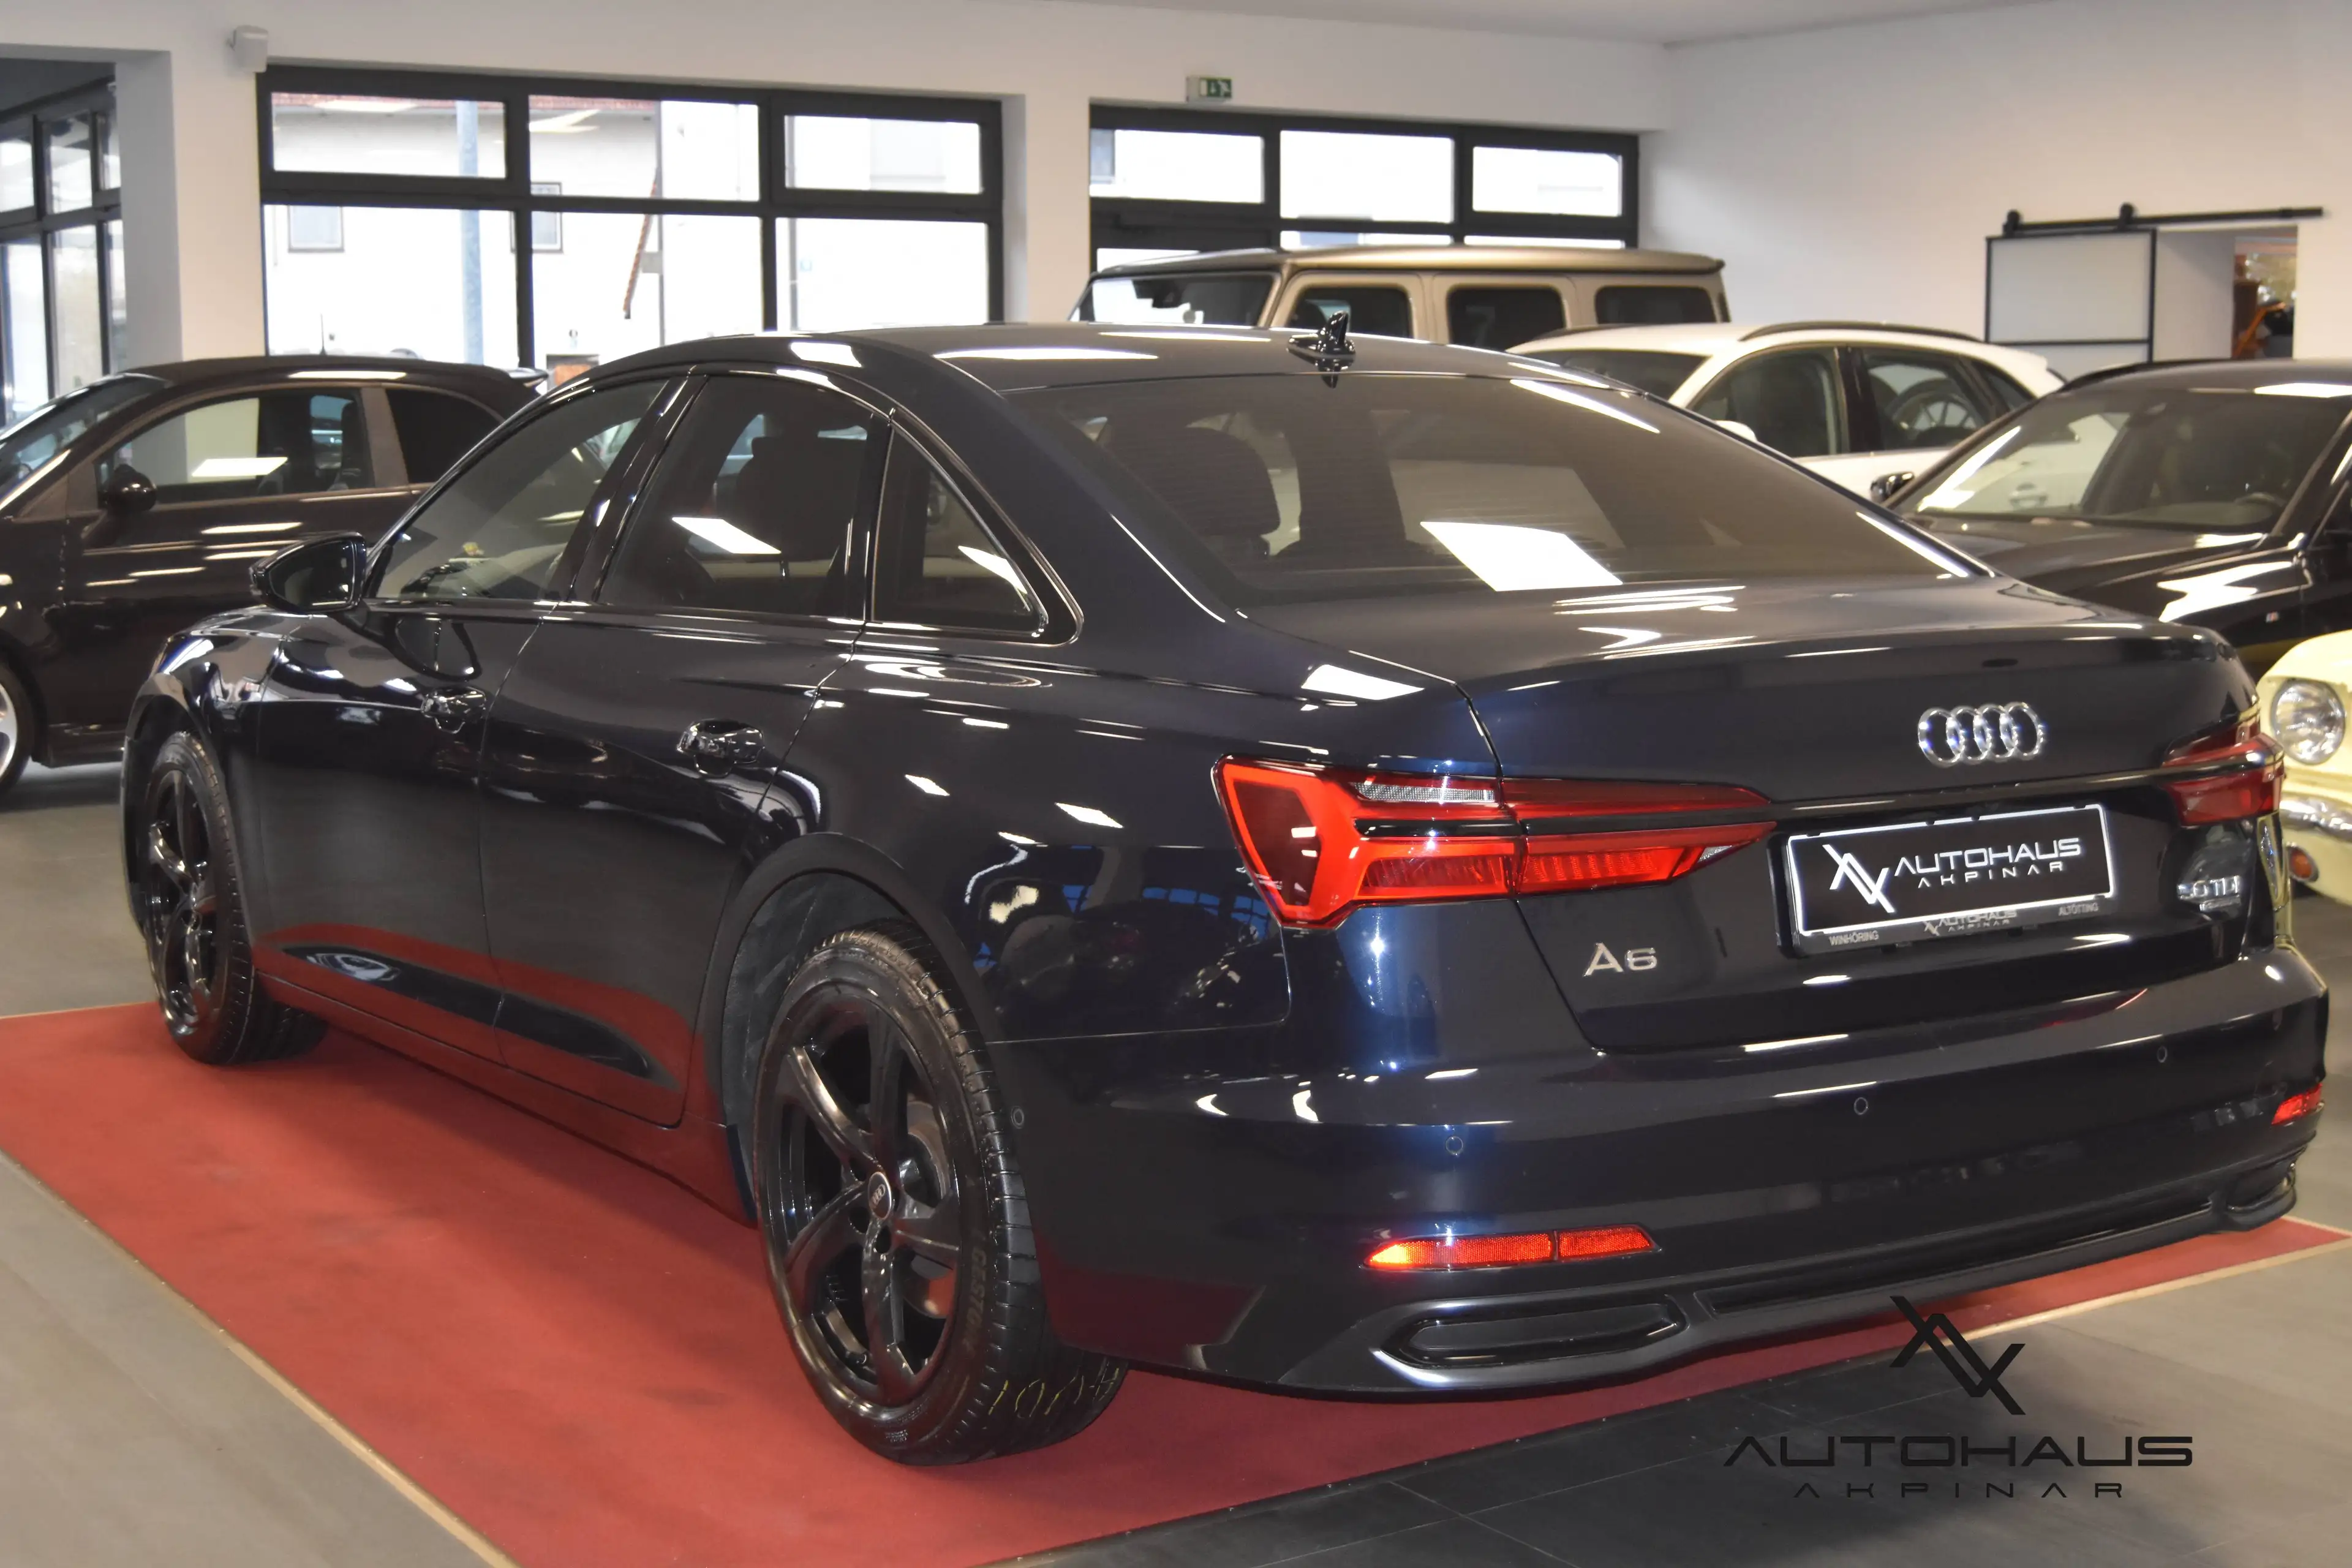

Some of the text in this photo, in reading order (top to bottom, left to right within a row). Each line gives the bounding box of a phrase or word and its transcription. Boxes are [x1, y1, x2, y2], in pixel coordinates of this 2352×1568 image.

[1894, 837, 2081, 876] AUTOHAUS
[1917, 861, 2065, 889] AKPINAR
[1582, 941, 1658, 978] A6
